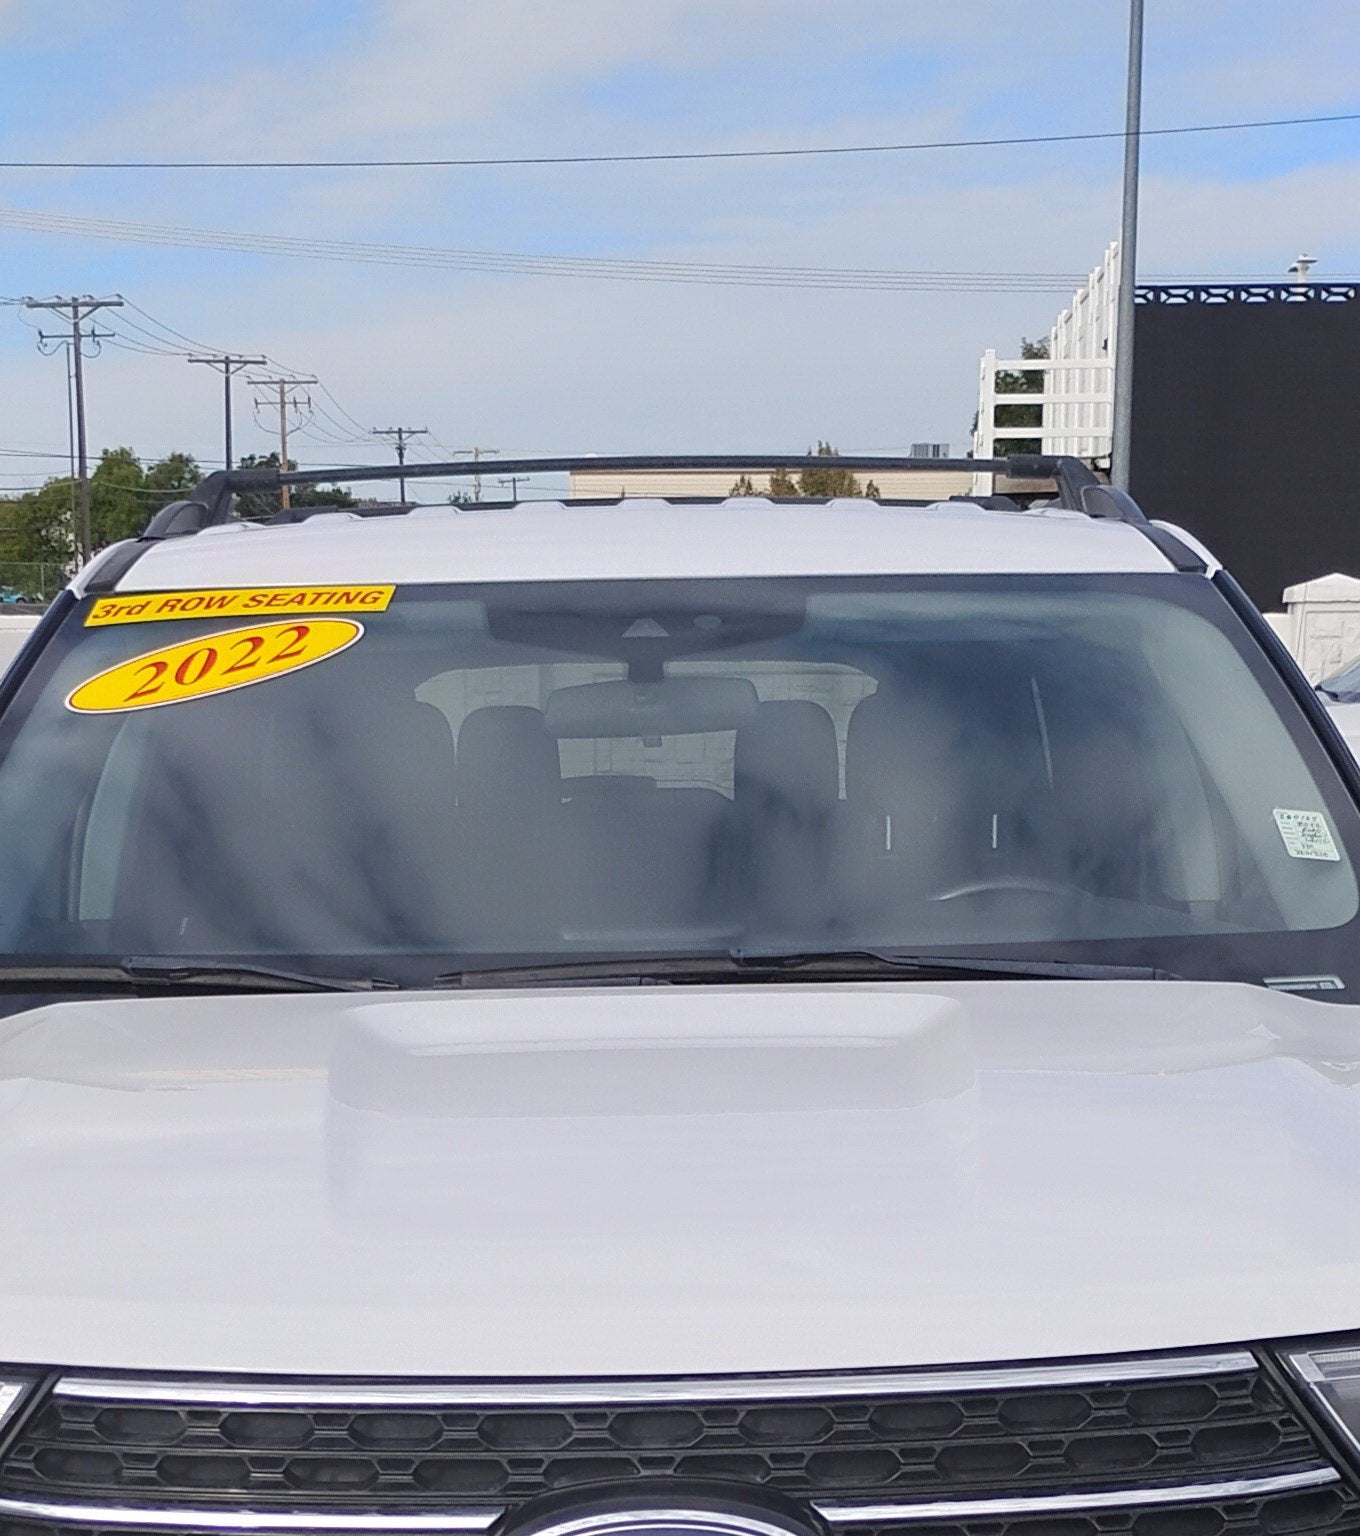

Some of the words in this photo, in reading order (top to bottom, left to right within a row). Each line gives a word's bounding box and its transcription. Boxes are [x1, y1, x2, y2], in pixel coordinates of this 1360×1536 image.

[92, 601, 147, 620] 3rd
[155, 594, 239, 615] ROW
[242, 589, 386, 609] SEATING
[122, 624, 311, 703] 2022
